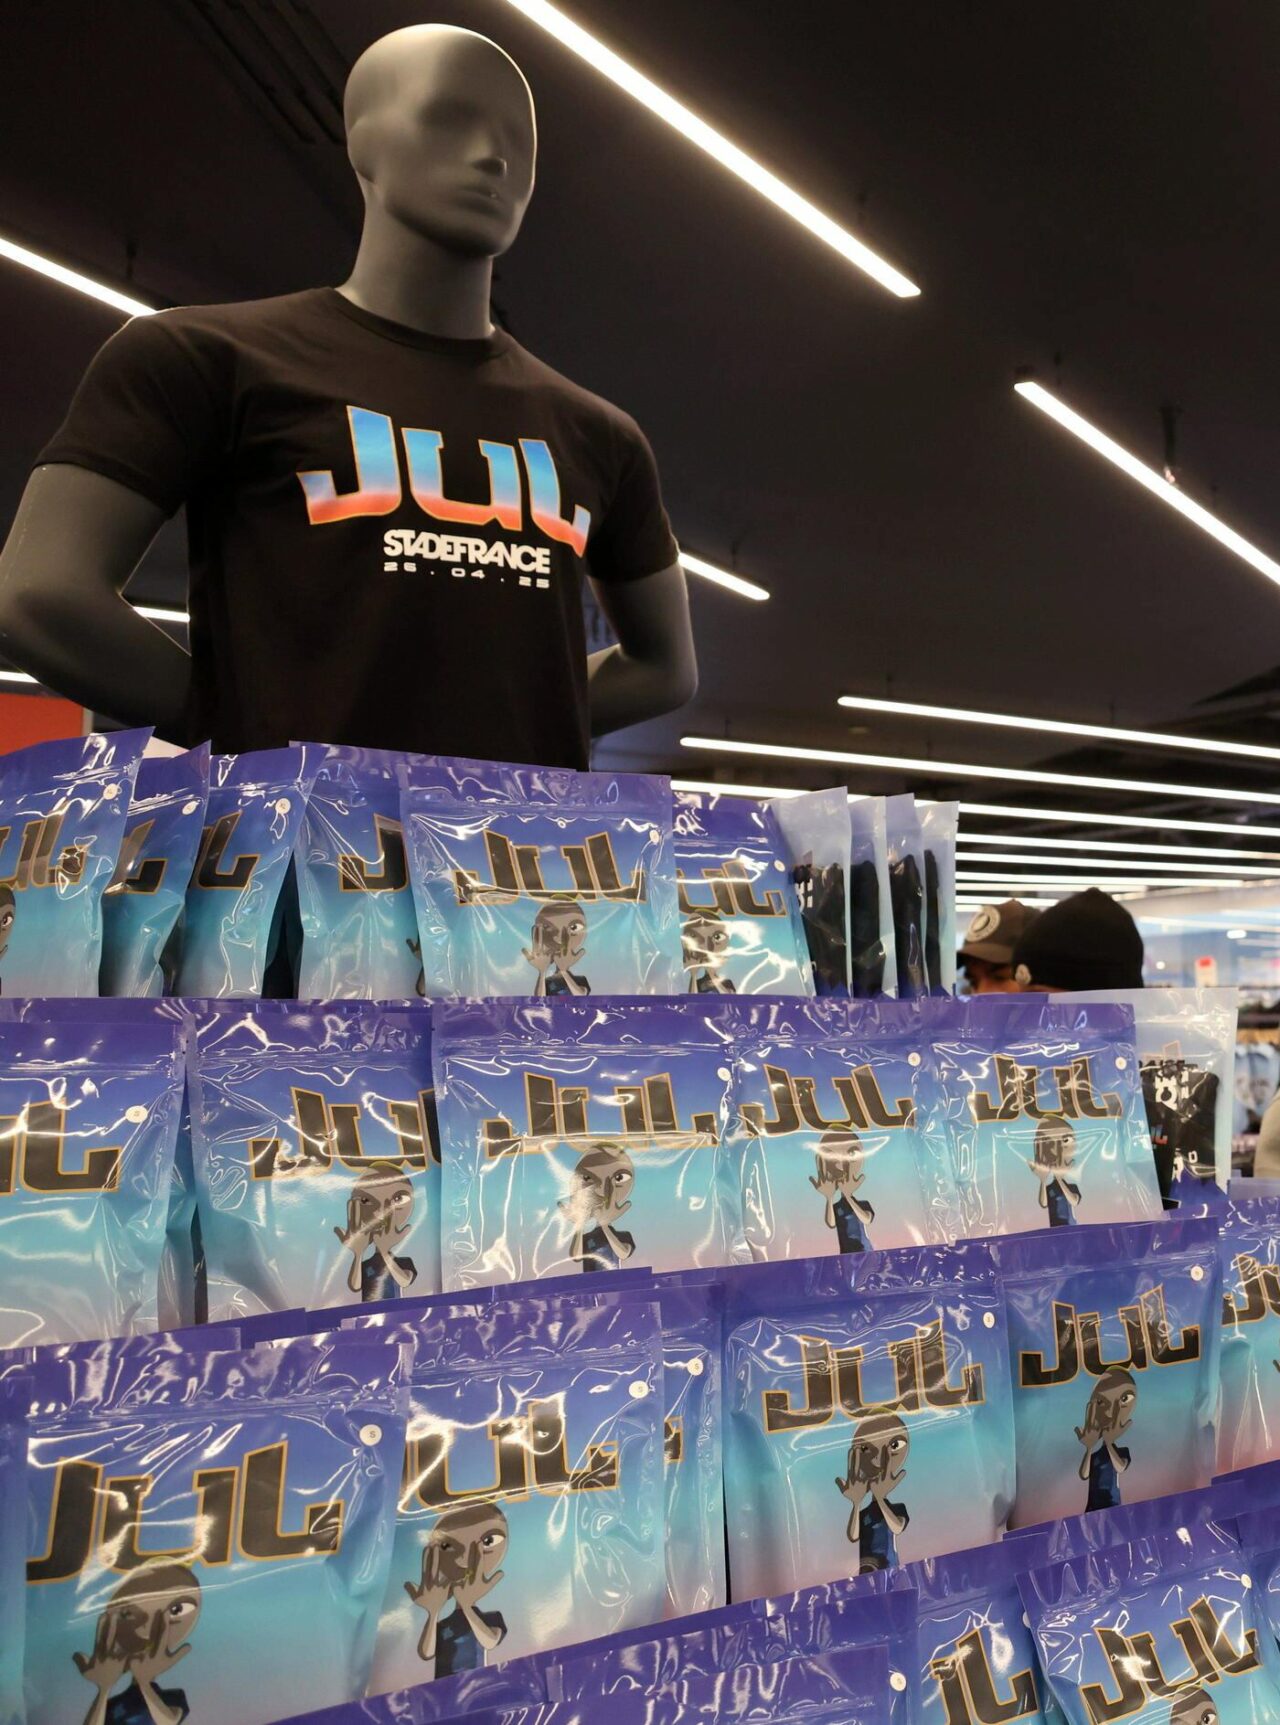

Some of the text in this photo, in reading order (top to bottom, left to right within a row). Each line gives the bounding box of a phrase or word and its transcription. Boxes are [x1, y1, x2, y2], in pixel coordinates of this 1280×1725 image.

[296, 405, 591, 558] JUL
[454, 829, 647, 905] JUL
[676, 859, 787, 918] UL
[482, 1072, 718, 1159] JUL
[740, 1064, 916, 1138] JUL
[973, 1053, 1124, 1123] JUL
[761, 1318, 986, 1435] JUL
[1020, 1282, 1200, 1388] JUL
[402, 1391, 619, 1516] UL
[26, 1441, 344, 1585] JUL
[1080, 1597, 1263, 1725] JUL
